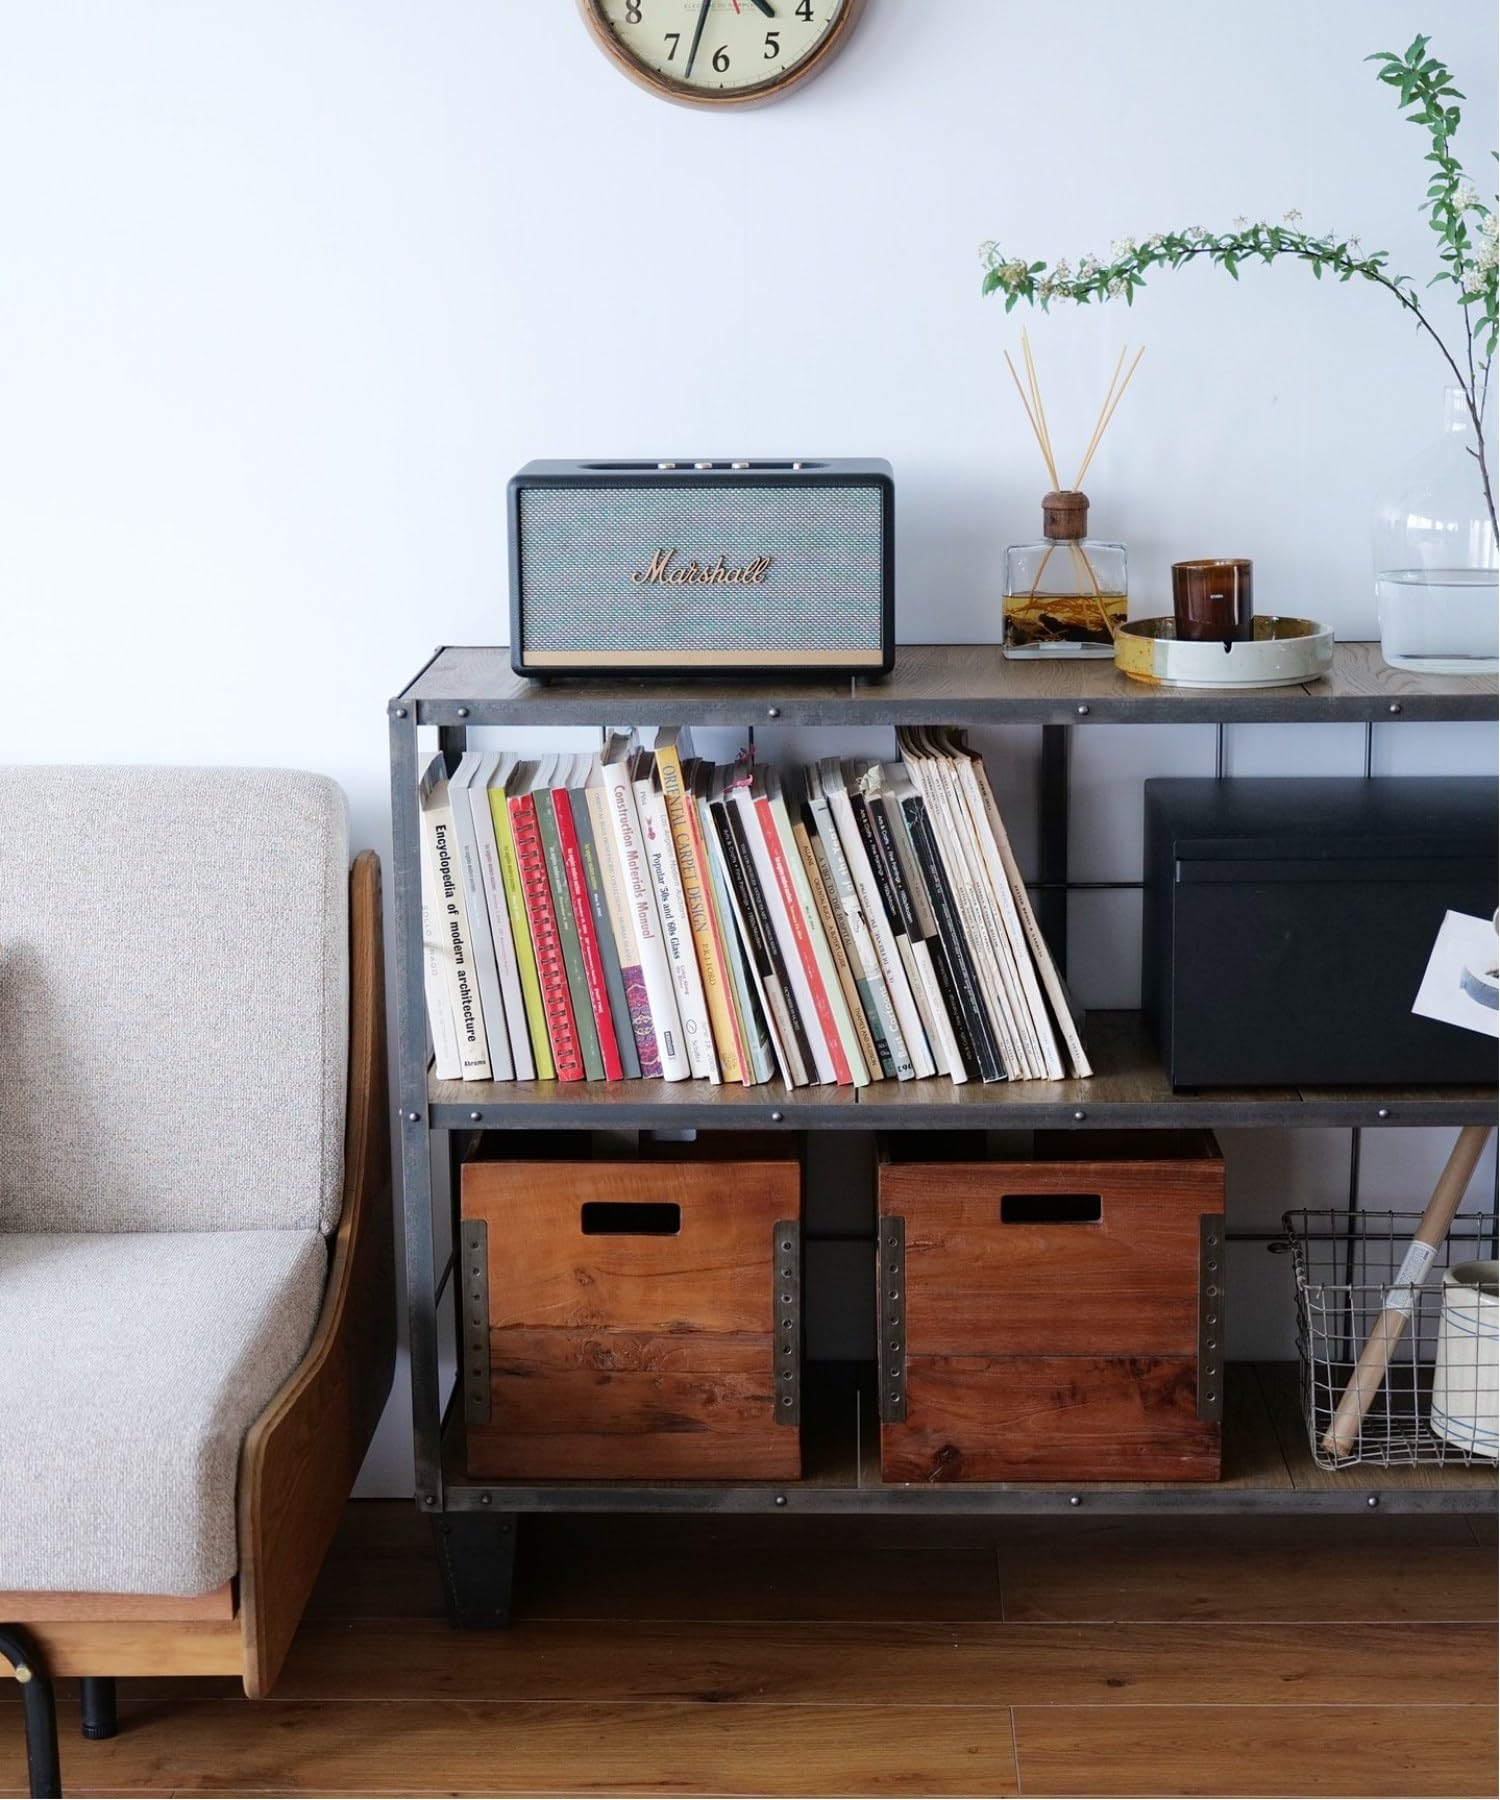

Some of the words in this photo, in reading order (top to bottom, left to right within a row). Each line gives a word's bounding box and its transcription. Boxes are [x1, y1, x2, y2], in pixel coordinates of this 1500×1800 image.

[625, 0, 643, 24] 8
[795, 0, 814, 22] 4
[664, 33, 680, 60] 7
[712, 45, 730, 72] 6
[763, 31, 780, 59] 5
[632, 548, 771, 584] Marshall
[662, 765, 686, 829] ORIENTAL
[674, 833, 695, 882] CARPET
[686, 887, 706, 933] DESIGN
[829, 824, 842, 853] Year
[436, 825, 454, 897] Encyclopedia
[615, 785, 633, 846] Construction
[628, 850, 645, 897] Materials
[638, 901, 654, 938] Manual
[653, 853, 664, 883] Popular
[838, 854, 849, 875] the
[660, 887, 669, 902] '50s
[842, 878, 854, 891] of
[447, 904, 459, 914] of
[663, 904, 673, 919] and
[820, 863, 830, 880] VISIT
[827, 884, 835, 894] TO
[832, 897, 840, 911] THE
[838, 912, 852, 946] HOSPITAL
[451, 922, 463, 964] modern
[667, 922, 676, 936] '60s
[670, 937, 680, 959] Glass
[458, 971, 475, 1041] architecture
[880, 983, 899, 1033] Cartoons
[855, 1008, 867, 1029] THAMES
[861, 1030, 869, 1042] AND
